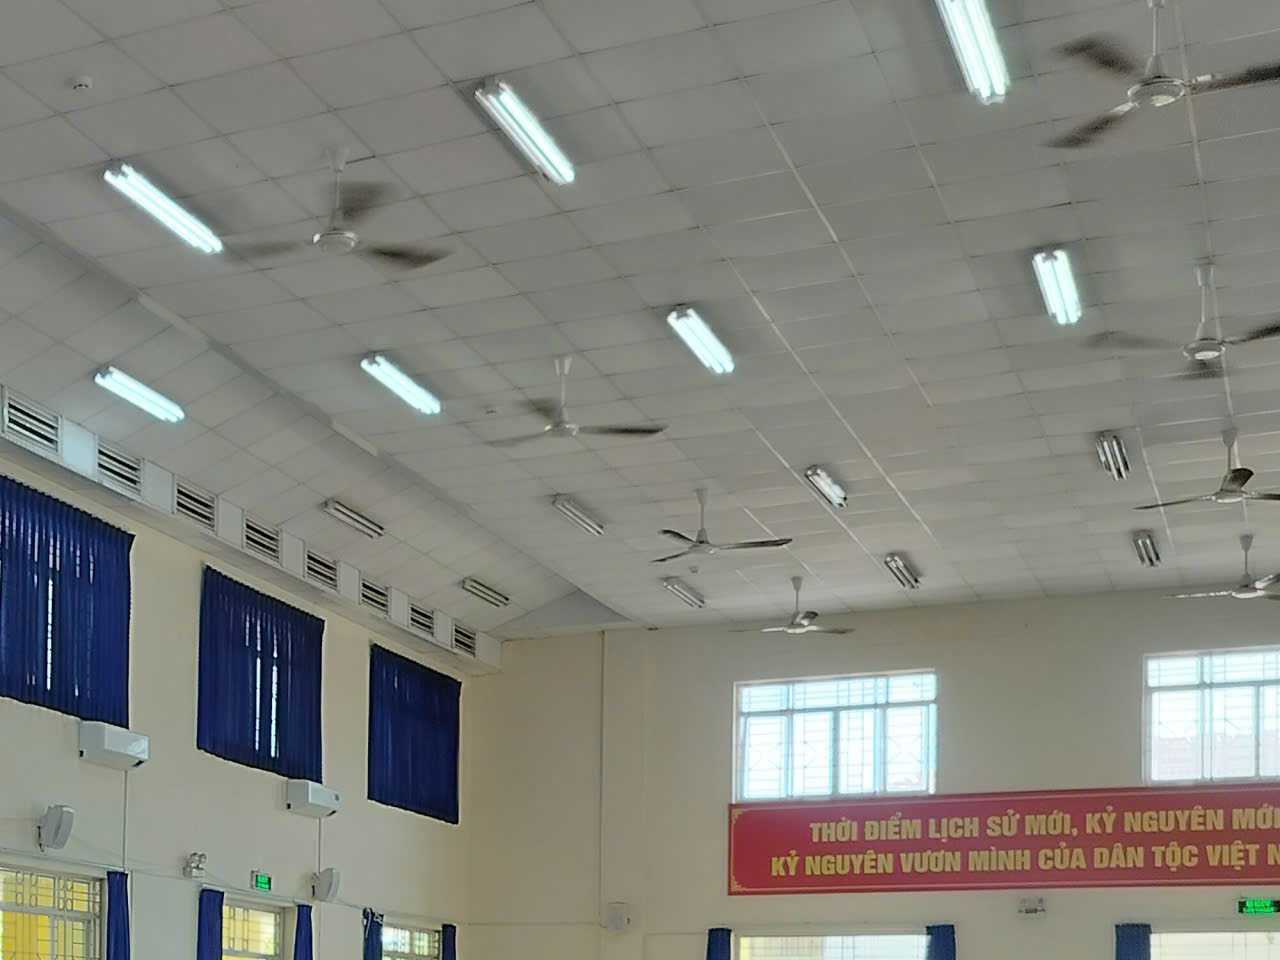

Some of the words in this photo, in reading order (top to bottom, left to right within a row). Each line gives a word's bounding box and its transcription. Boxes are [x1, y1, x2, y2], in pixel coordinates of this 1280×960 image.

[809, 816, 858, 843] THỜI
[863, 811, 922, 841] ĐIỂM
[928, 817, 980, 843] LỊCH
[986, 808, 1020, 837] SỬ
[1024, 808, 1078, 837] MỚI,
[1085, 804, 1116, 834] KỶ
[1123, 805, 1224, 832] NGUYÊN
[770, 849, 799, 877] KỶ
[805, 849, 894, 876] NGUYÊN
[899, 850, 961, 873] VƯƠN
[968, 846, 1031, 872] MÌNH
[1038, 841, 1087, 870] CỦA
[1093, 842, 1144, 869] DÂN
[1151, 841, 1199, 872] TỘC
[1205, 839, 1260, 871] VIỆT
